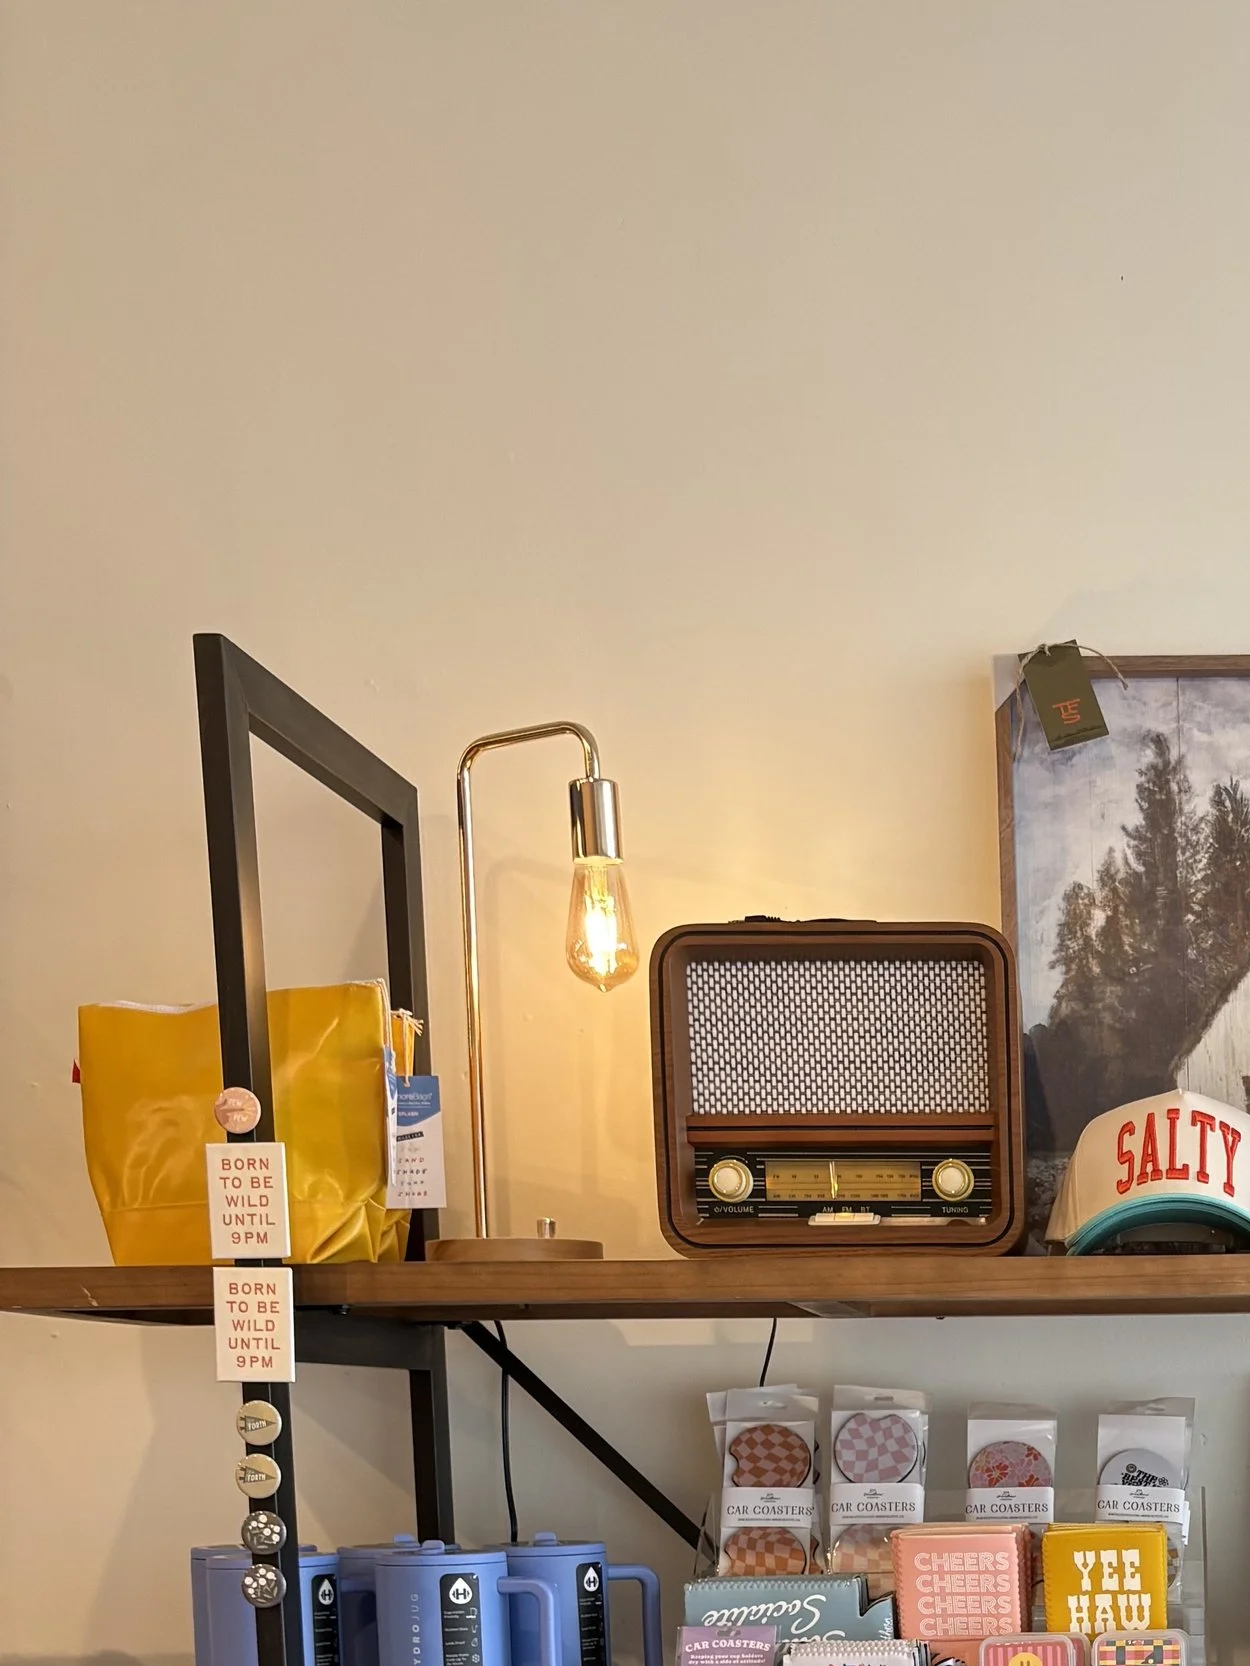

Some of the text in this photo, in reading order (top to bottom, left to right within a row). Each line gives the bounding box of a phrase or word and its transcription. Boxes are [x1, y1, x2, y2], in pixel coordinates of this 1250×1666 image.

[1116, 1108, 1241, 1198] SALTY
[222, 1158, 270, 1172] BORN
[219, 1176, 274, 1189] TO BE
[225, 1194, 270, 1208] WILD
[941, 1206, 969, 1214] TUNING
[222, 1213, 276, 1226] UNTIL
[231, 1231, 269, 1245] 9PM
[229, 1283, 277, 1296] BORN
[226, 1300, 280, 1314] TO BE
[232, 1319, 276, 1332] WILD
[228, 1337, 281, 1350] UNTIL
[237, 1356, 273, 1368] 9PM
[727, 1505, 812, 1516] CAR COASTERS
[831, 1501, 916, 1513] CAR COASTERS
[965, 1502, 1049, 1514] CAR COASTERS
[1097, 1499, 1180, 1513] CAR COASTERS
[914, 1551, 1010, 1572] CHEERS
[1073, 1549, 1142, 1591] YEE
[915, 1573, 1011, 1593] CHEERS
[917, 1595, 1012, 1615] CHEERS
[1067, 1593, 1152, 1634] HAW
[919, 1617, 1013, 1637] CHEERS
[685, 1639, 771, 1652] CAR COASTERS
